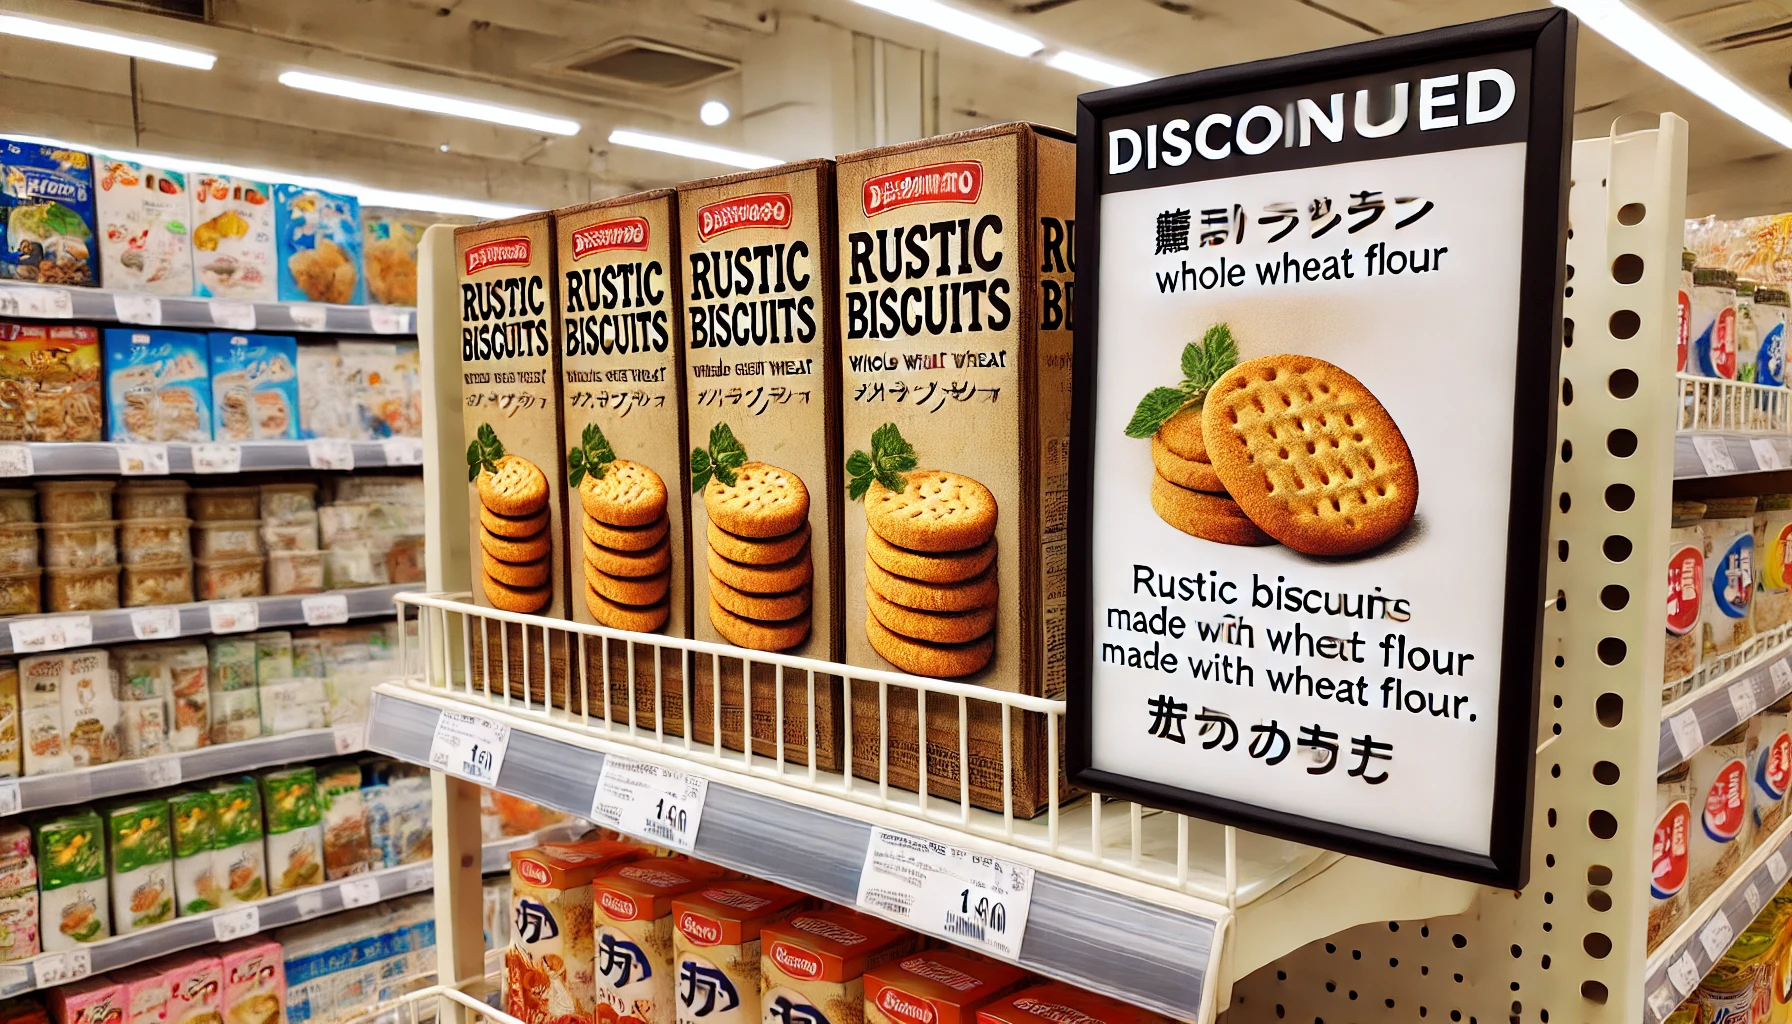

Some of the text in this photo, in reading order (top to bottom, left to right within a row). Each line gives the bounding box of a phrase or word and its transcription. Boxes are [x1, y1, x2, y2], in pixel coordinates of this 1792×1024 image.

[689, 240, 811, 301] RUSTIC
[848, 214, 1003, 285] RUSTIC
[1155, 241, 1449, 294] whole wheat flour
[461, 275, 545, 322] RUSTIC
[565, 260, 665, 313] RUSTIC
[846, 277, 1011, 340] BISCUITS
[462, 319, 549, 362] BISCUITS
[564, 310, 669, 357] BISCUITS
[688, 295, 817, 349] BISCUITS
[1132, 564, 1238, 605] Rustic
[1107, 607, 1187, 640] made
[1379, 633, 1476, 677] flour
[1102, 641, 1478, 723] made with wheat flour.
